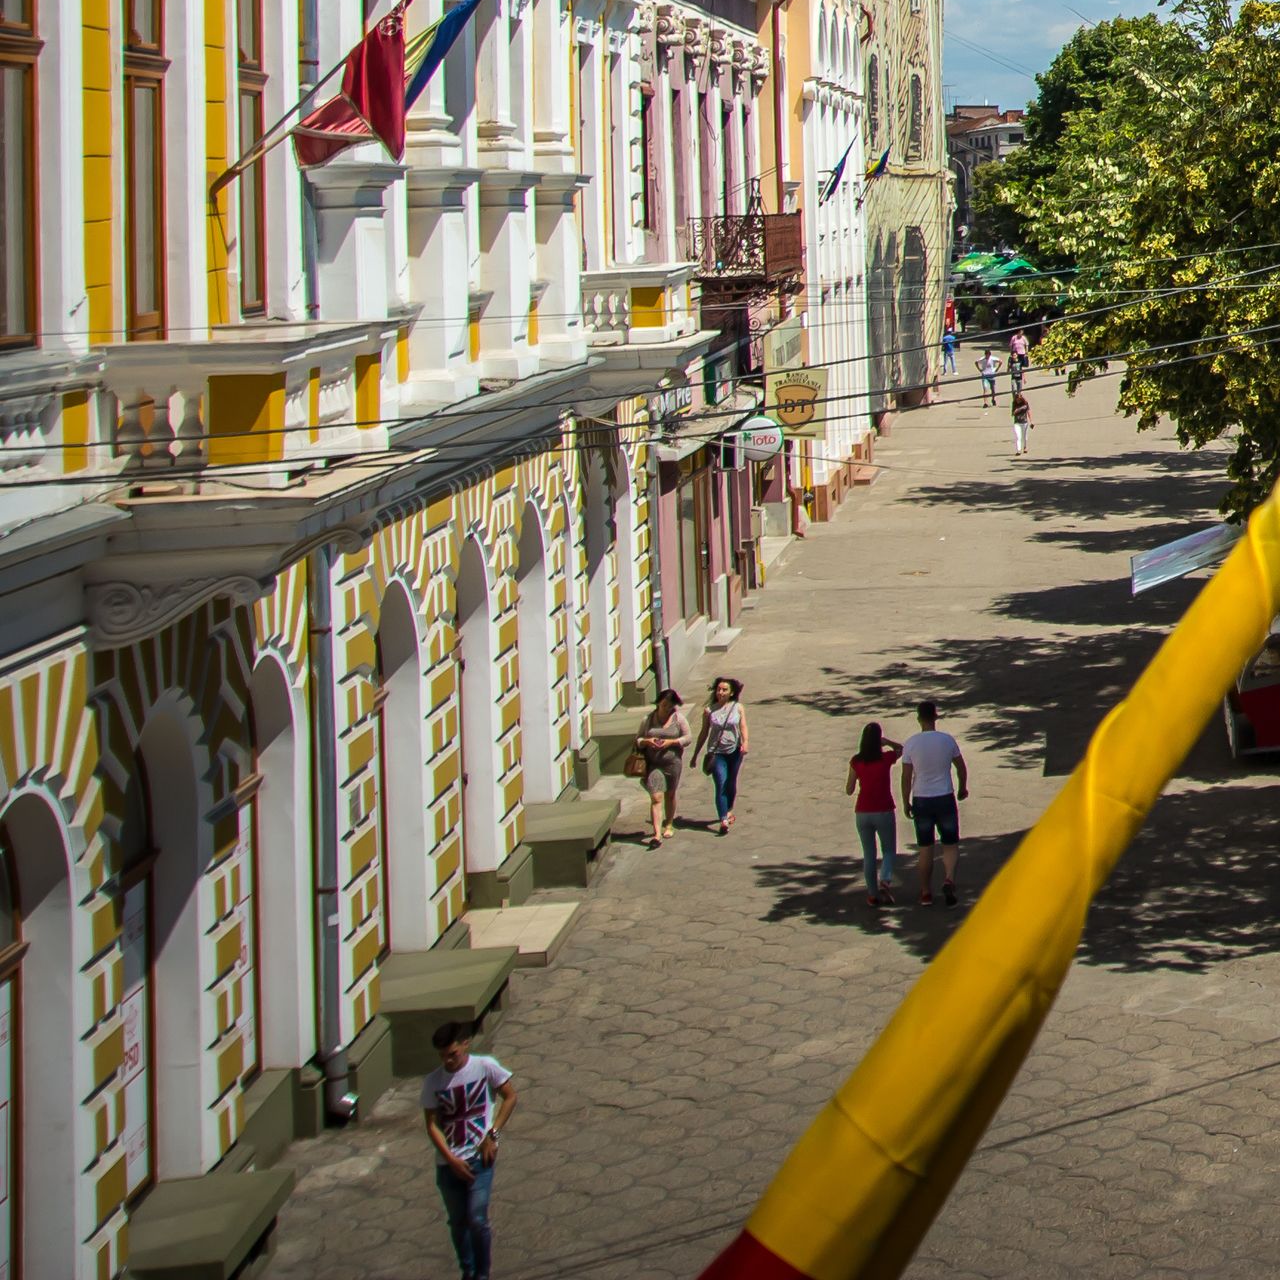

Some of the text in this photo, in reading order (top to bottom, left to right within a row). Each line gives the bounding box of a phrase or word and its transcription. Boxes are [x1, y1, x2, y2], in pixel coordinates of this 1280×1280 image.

[785, 372, 809, 380] BANCA
[774, 378, 822, 390] TRANSILVANIA
[784, 398, 809, 414] BT
